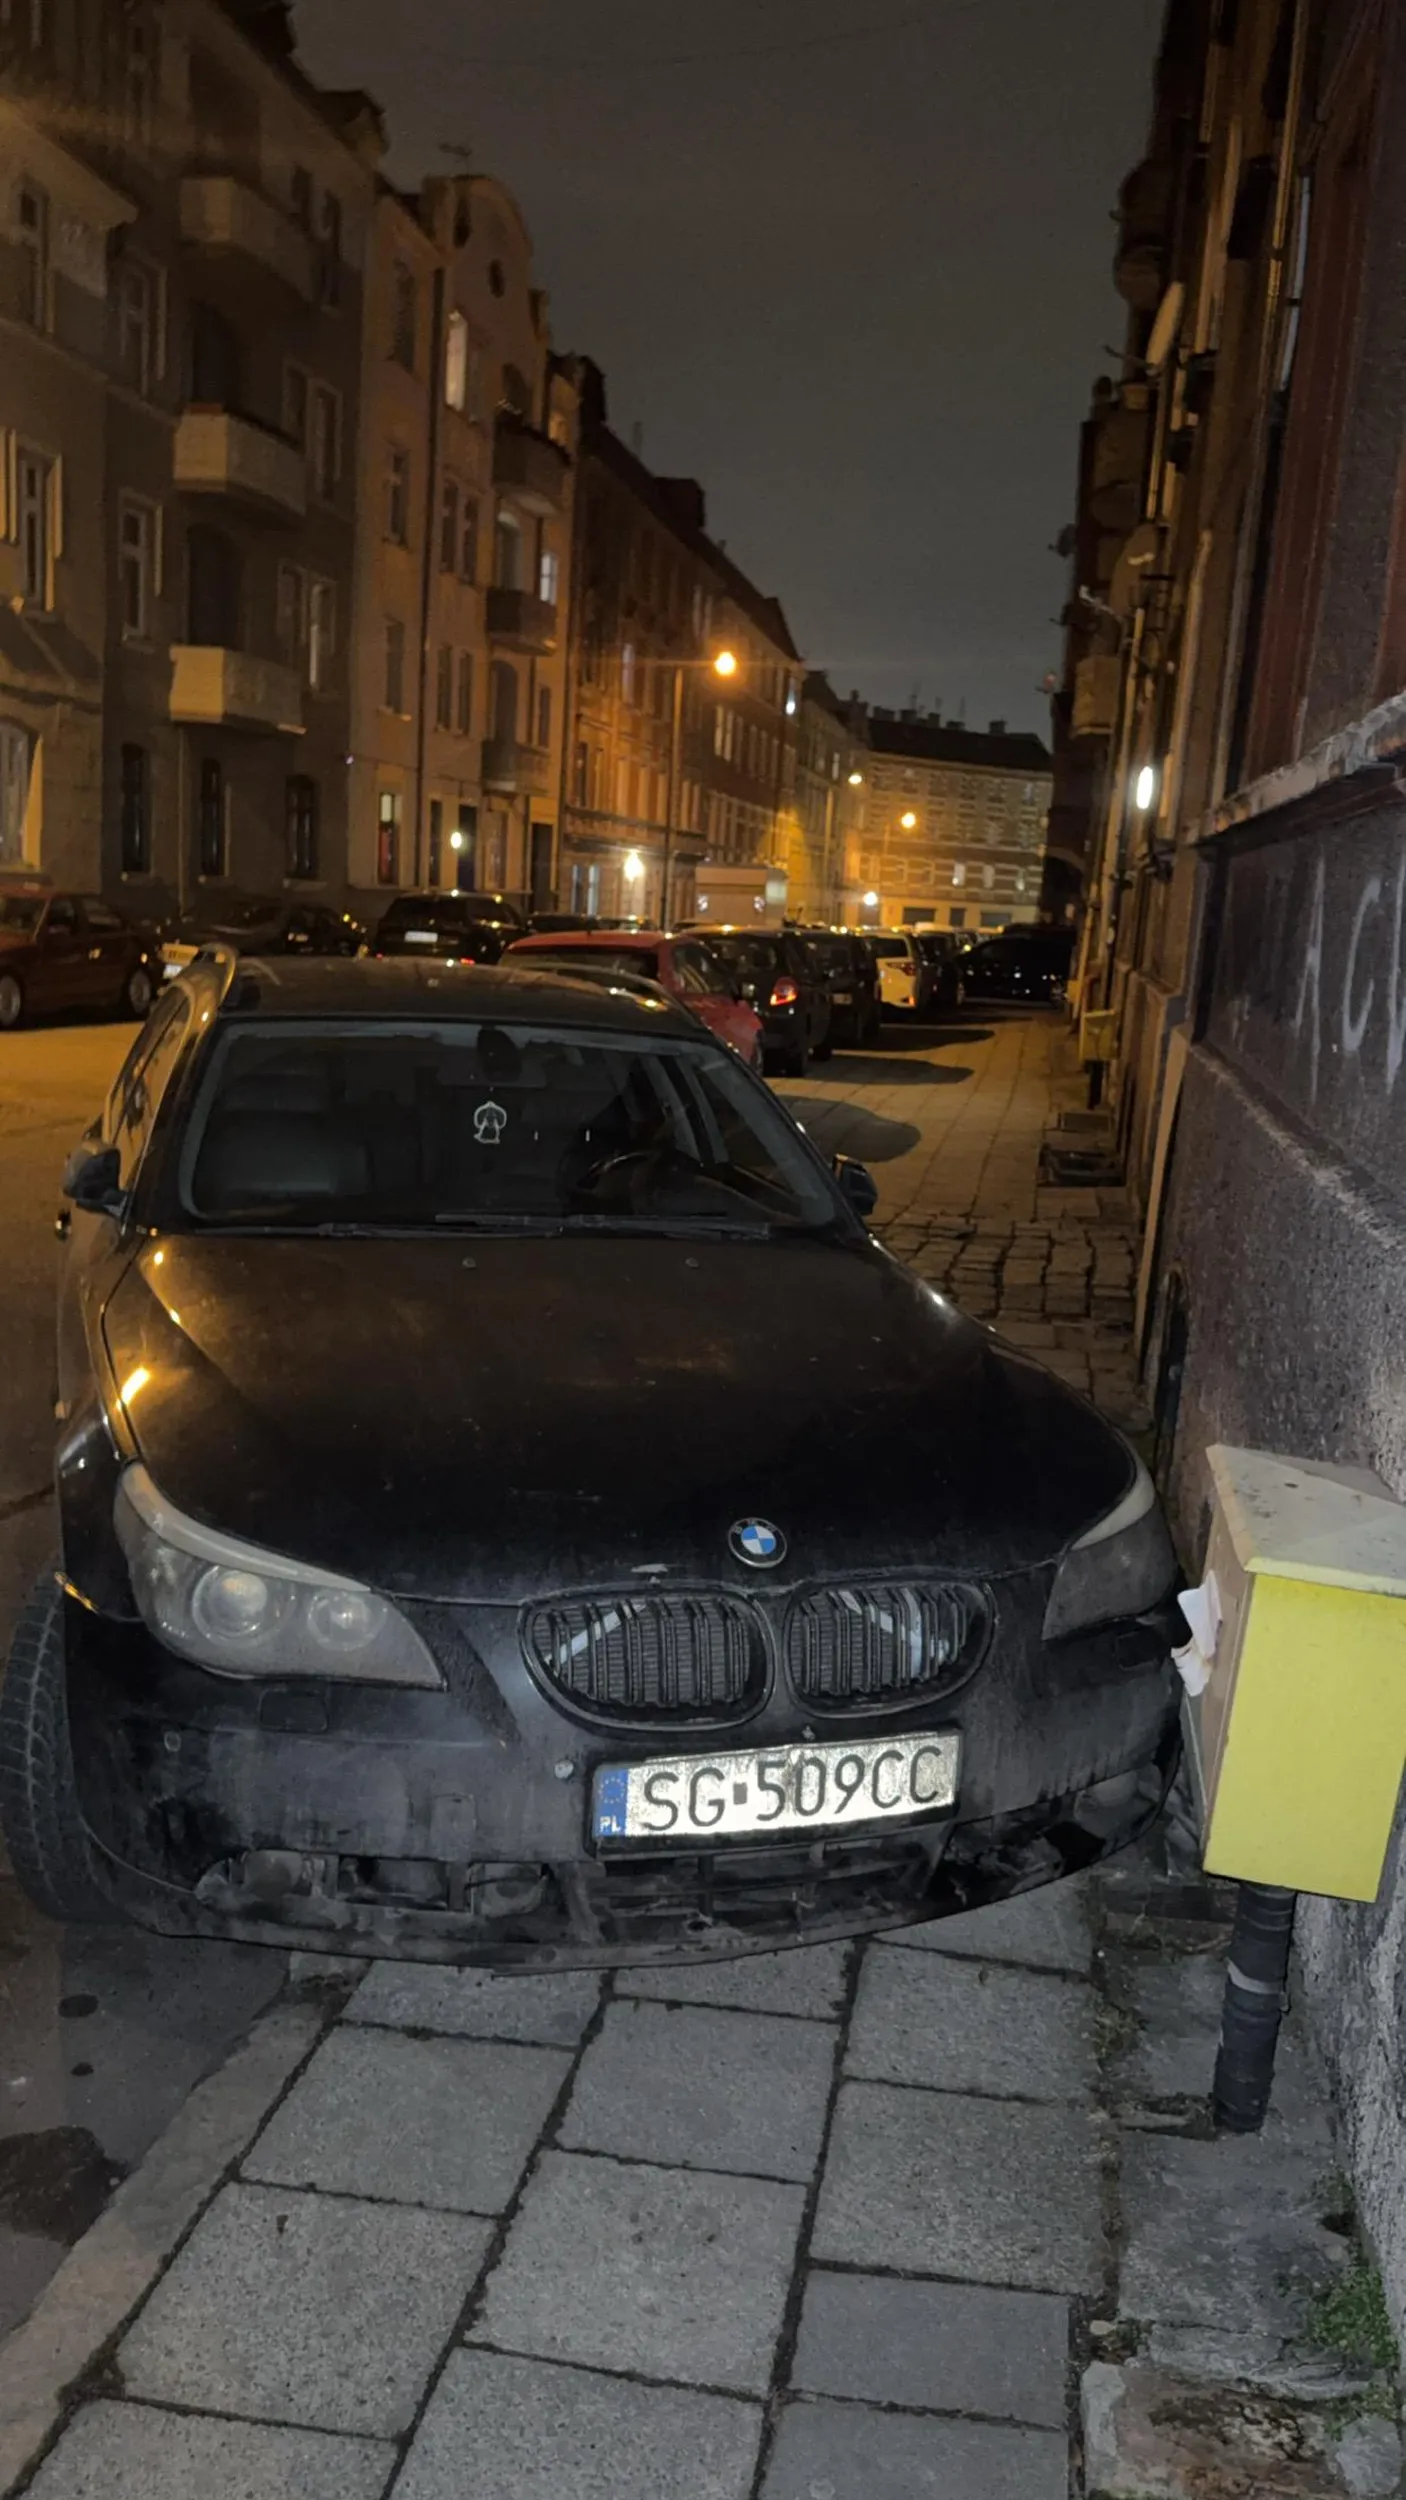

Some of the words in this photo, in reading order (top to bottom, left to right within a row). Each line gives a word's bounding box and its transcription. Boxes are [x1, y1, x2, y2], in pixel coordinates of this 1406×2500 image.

[641, 1767, 726, 1831] SG
[756, 1745, 943, 1822] 509CC
[599, 1815, 621, 1833] PL
